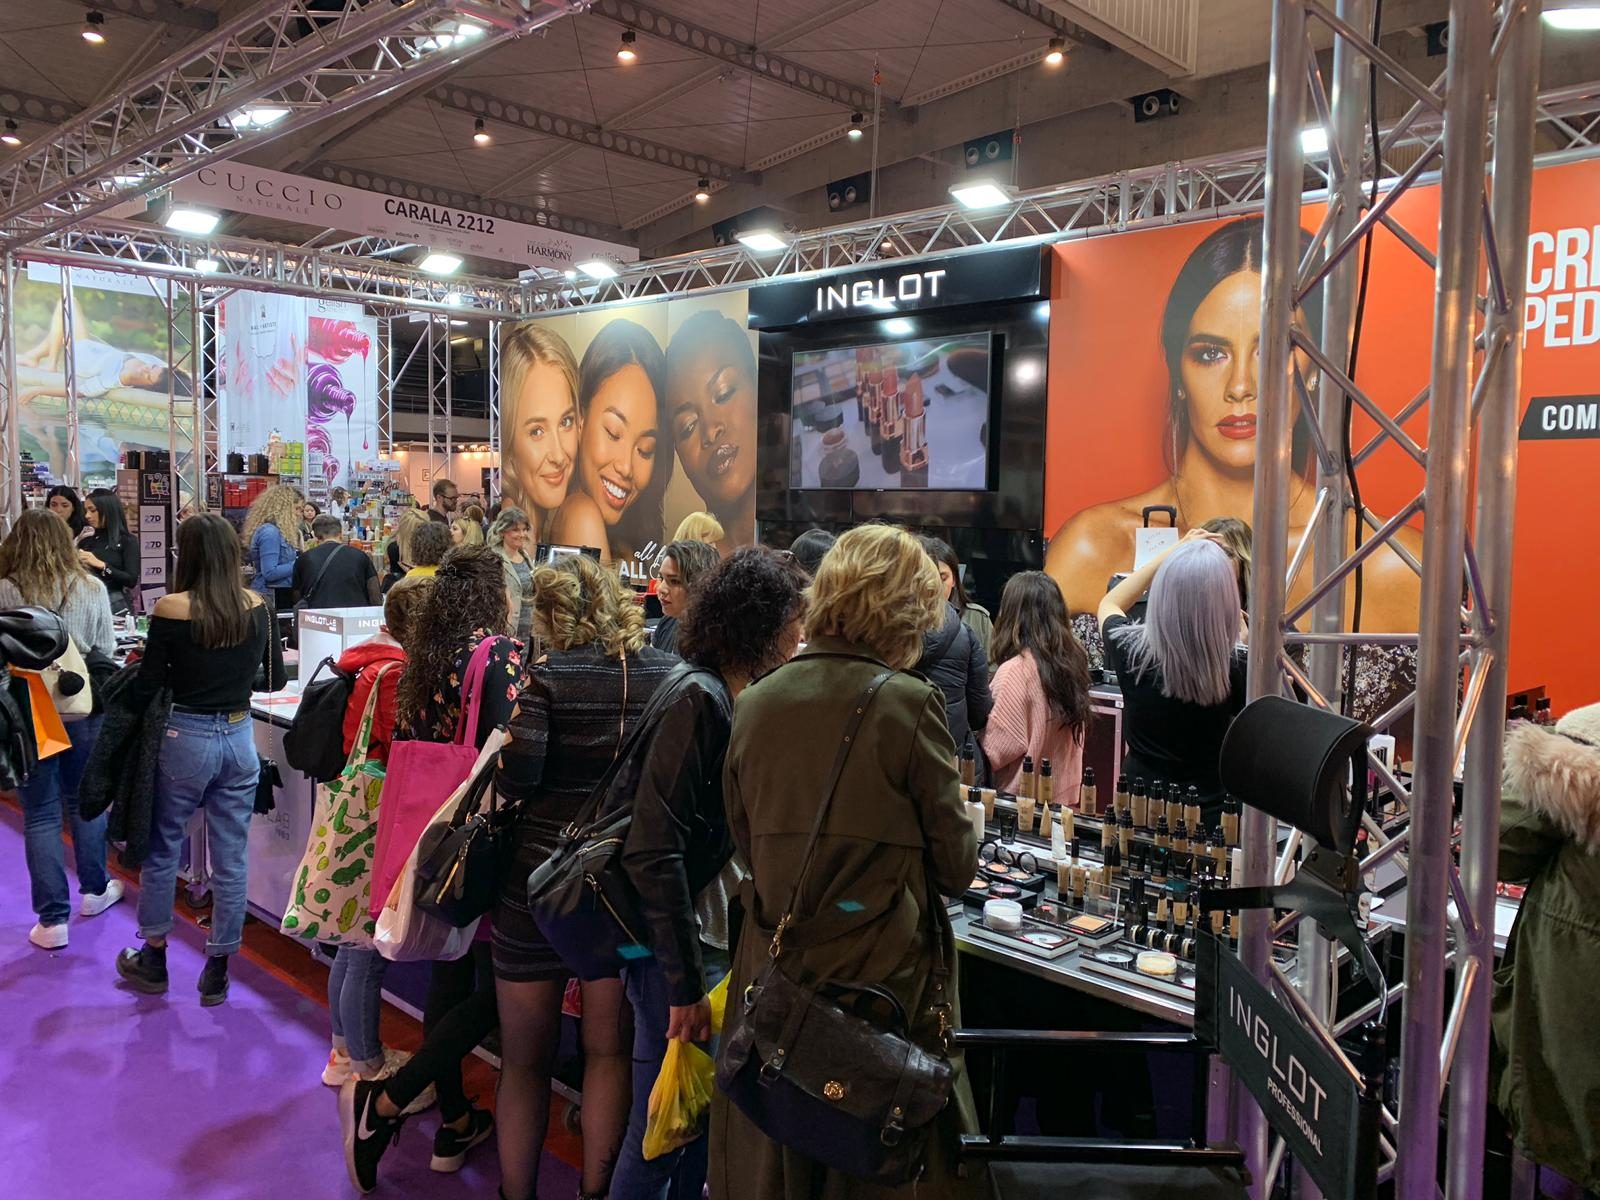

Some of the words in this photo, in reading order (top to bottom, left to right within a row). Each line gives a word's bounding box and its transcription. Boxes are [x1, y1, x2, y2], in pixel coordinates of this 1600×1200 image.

[197, 168, 342, 210] CUCCIO
[236, 195, 310, 215] NATURALE
[384, 199, 452, 226] CARALA
[457, 213, 495, 235] 2212
[527, 244, 572, 263] HARMONY
[817, 269, 946, 312] INGLOT
[1542, 403, 1600, 431] COM
[633, 540, 657, 561] all
[618, 560, 647, 579] ALL
[1230, 986, 1327, 1121] INGLOT
[1267, 1076, 1323, 1157] PROFESSIONAL
